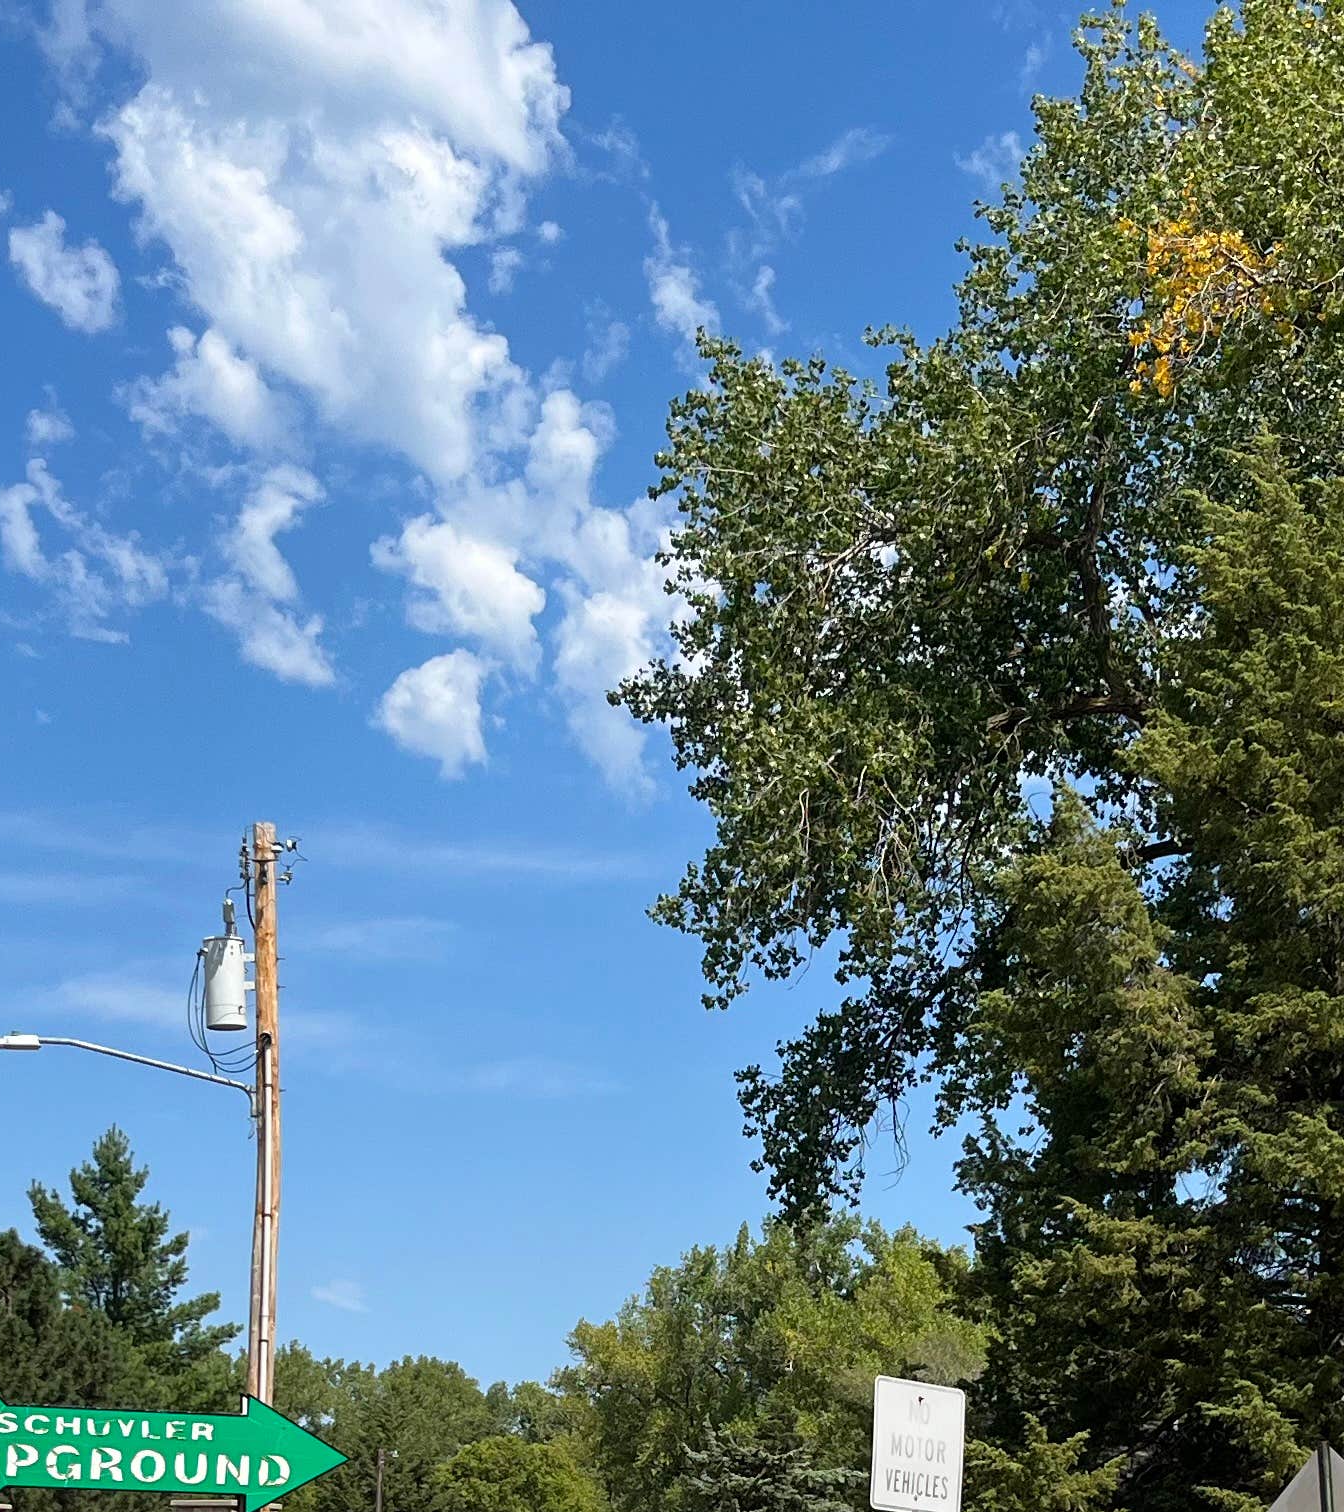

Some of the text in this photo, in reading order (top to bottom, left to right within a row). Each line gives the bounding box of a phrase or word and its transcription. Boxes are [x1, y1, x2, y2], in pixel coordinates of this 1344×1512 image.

[909, 1399, 930, 1425] NO
[890, 1432, 947, 1465] MOTOR
[885, 1468, 949, 1500] VEHICLES
